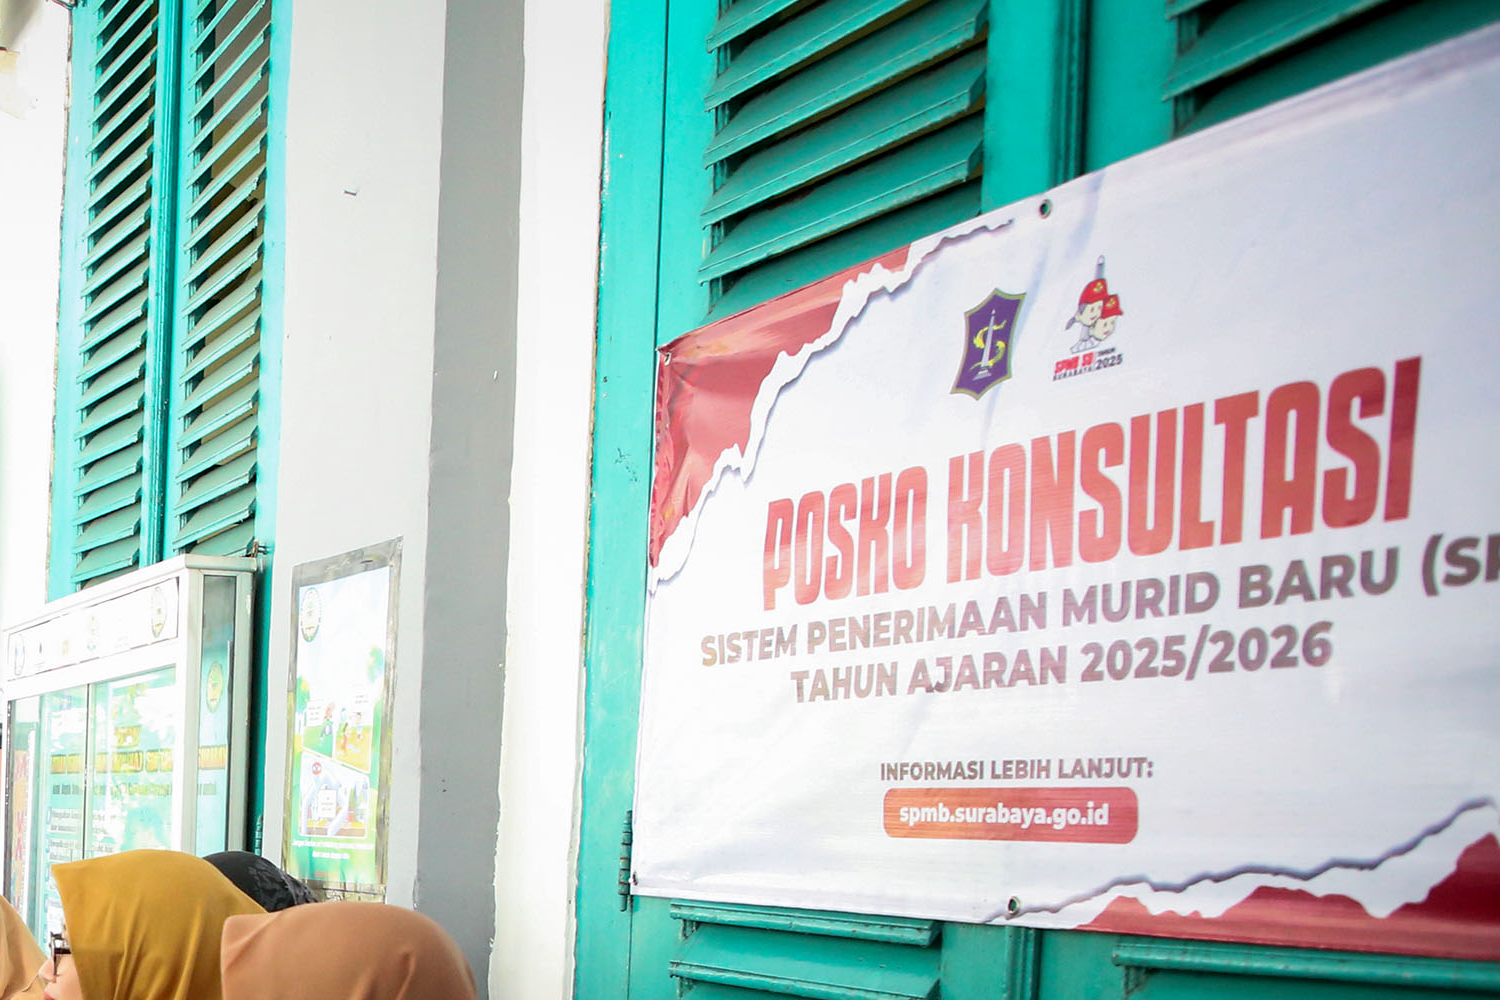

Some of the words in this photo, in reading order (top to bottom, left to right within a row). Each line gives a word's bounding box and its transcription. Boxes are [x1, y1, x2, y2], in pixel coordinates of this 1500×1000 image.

[1096, 353, 1124, 369] 2025
[763, 466, 928, 611] POSKO
[946, 355, 1422, 584] KONSULTASI
[701, 624, 797, 667] SISTEM
[807, 592, 1047, 655] PENERIMAAN
[1062, 571, 1221, 627] MURID
[1238, 546, 1399, 609] BARU
[790, 661, 898, 703] TAHUN
[907, 645, 1067, 695] AJARAN
[1080, 620, 1334, 683] 2025/2026
[880, 760, 984, 781] INFORMASI
[990, 758, 1050, 779] LEBIH
[1057, 756, 1154, 779] LANJUT:
[899, 801, 1109, 829] spmb.surabaya.go.id
